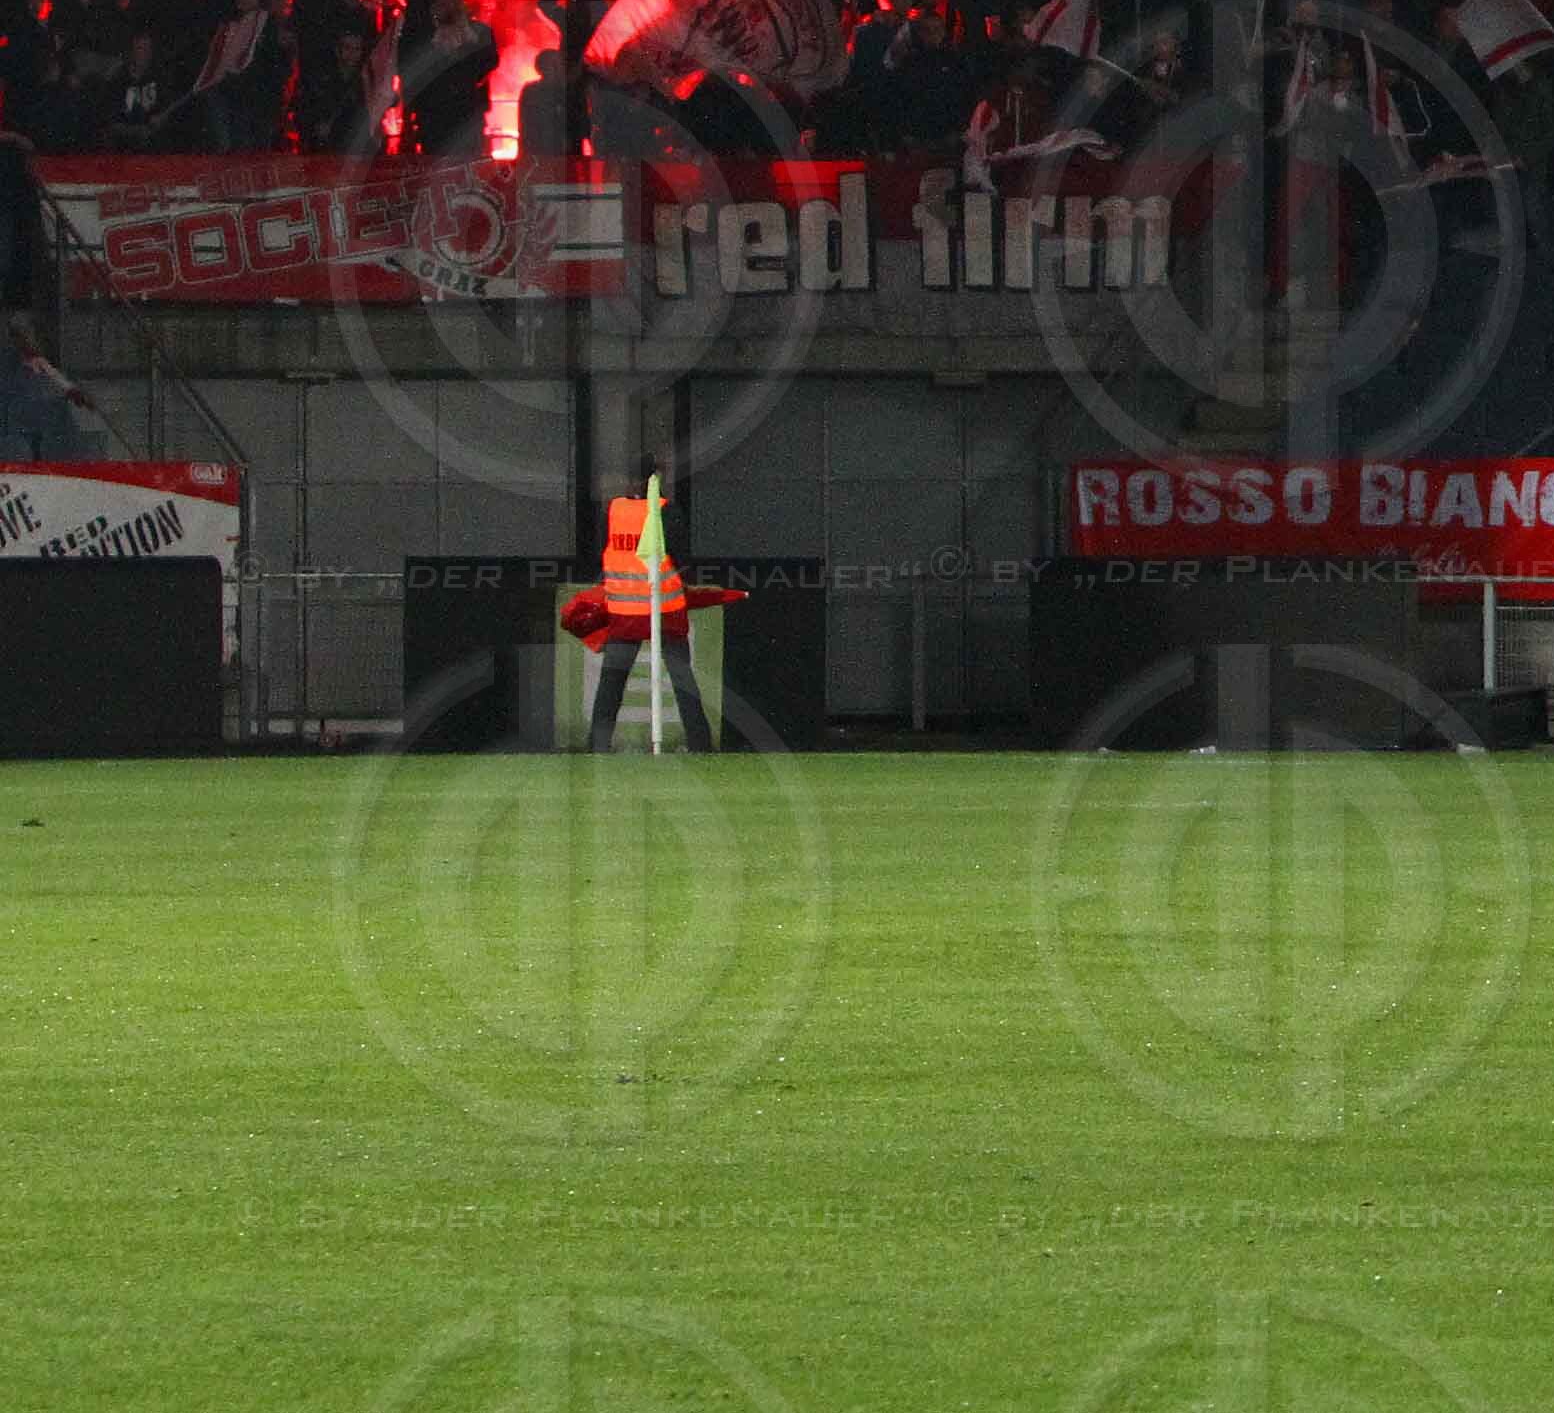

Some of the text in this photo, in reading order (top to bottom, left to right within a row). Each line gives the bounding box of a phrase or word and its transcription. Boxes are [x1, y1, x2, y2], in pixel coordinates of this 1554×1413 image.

[652, 168, 1173, 295] red firm
[1077, 468, 1332, 526] ROSSO
